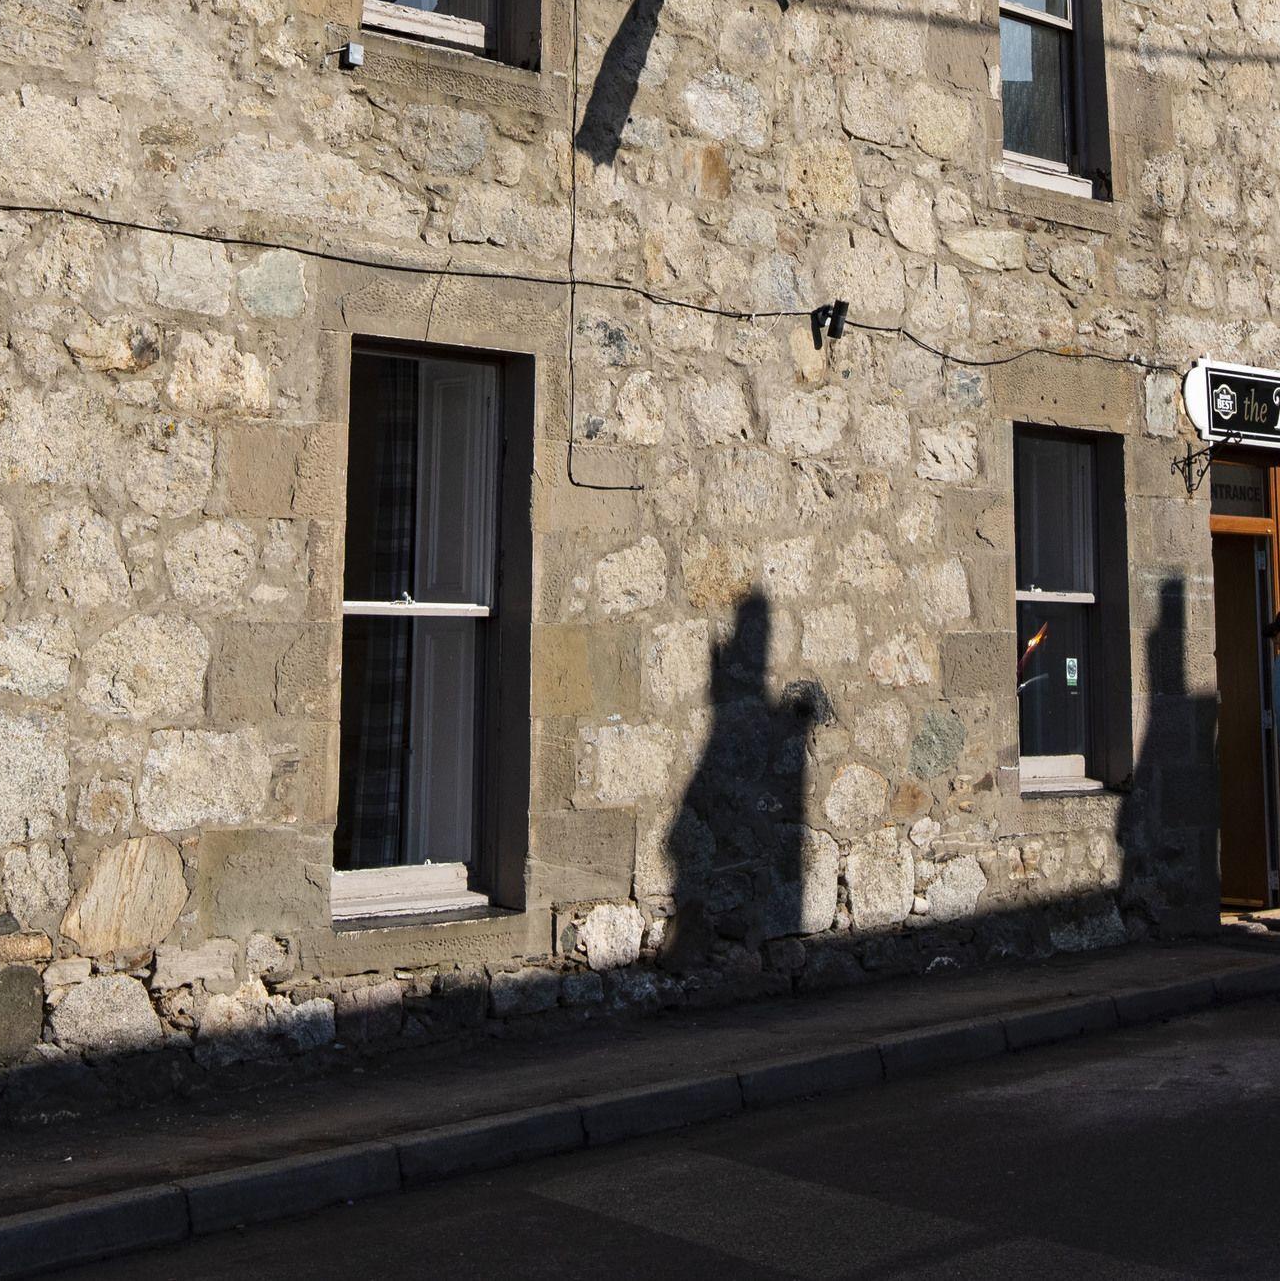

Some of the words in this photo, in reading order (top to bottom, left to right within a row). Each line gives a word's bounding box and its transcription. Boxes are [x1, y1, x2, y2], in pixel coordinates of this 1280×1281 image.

[1217, 398, 1234, 410] BEST
[1243, 388, 1268, 423] the
[1212, 483, 1261, 502] NTRANCE
